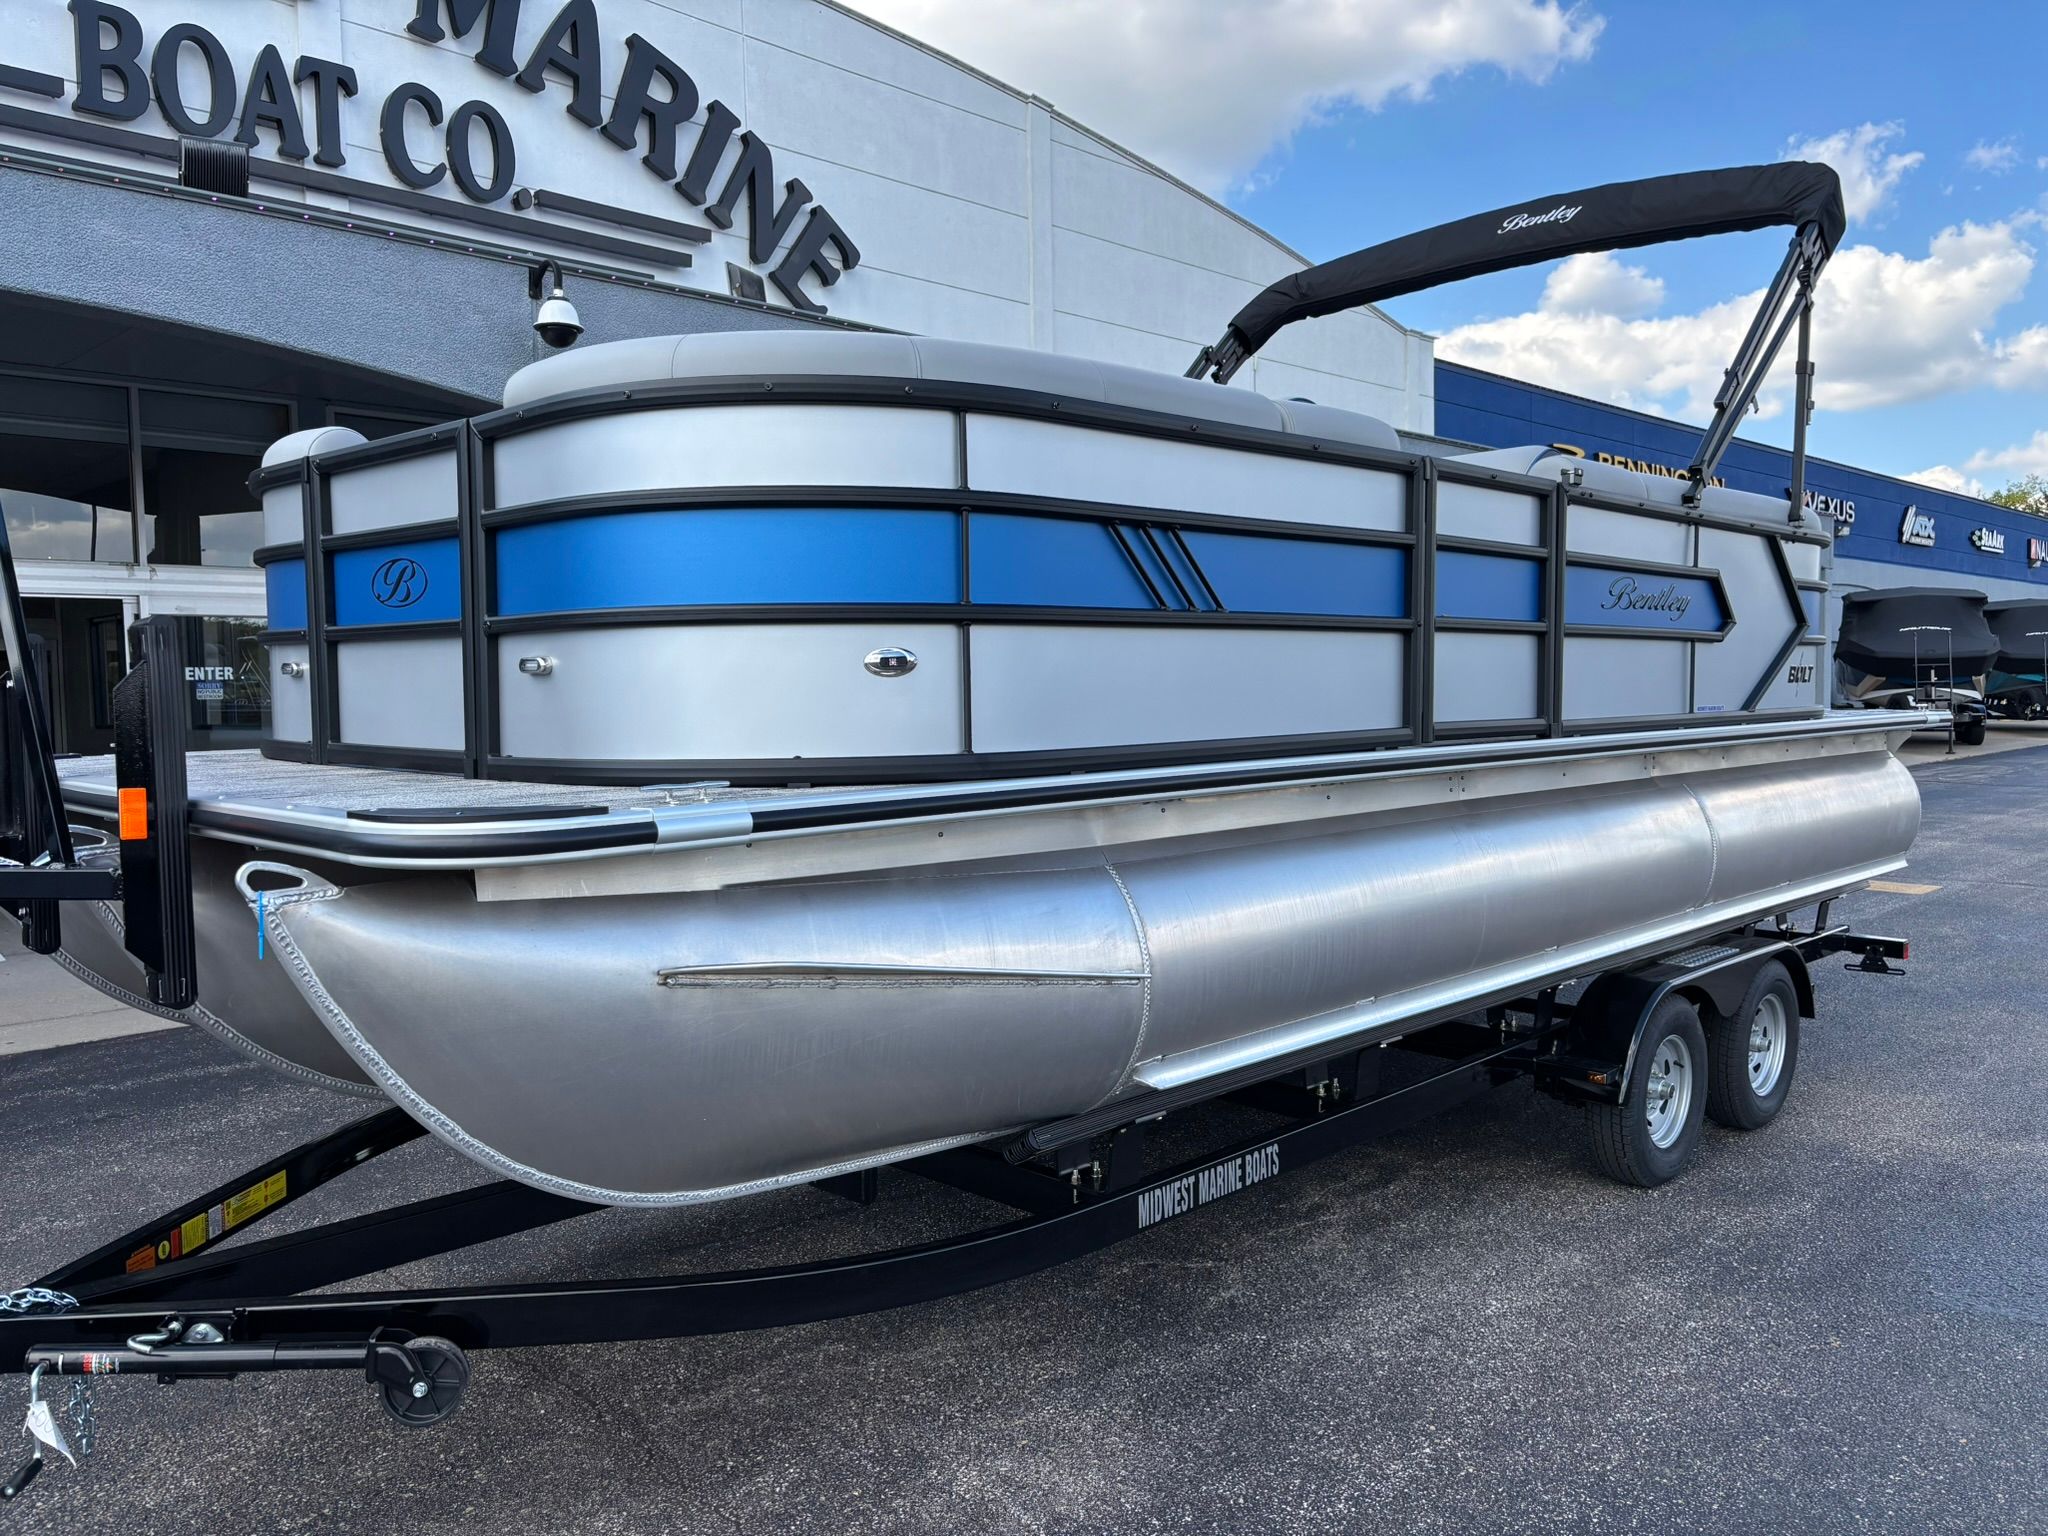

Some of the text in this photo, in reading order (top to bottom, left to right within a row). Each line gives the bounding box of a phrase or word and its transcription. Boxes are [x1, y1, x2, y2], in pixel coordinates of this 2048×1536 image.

[67, 0, 533, 211] BOAT CO.
[405, 0, 860, 315] MARINE
[1497, 205, 1583, 234] Bentley
[1601, 576, 1691, 622] Bentley
[185, 666, 234, 681] ENTER
[1138, 1143, 1280, 1229] MIDWEST MARINE BOATS
